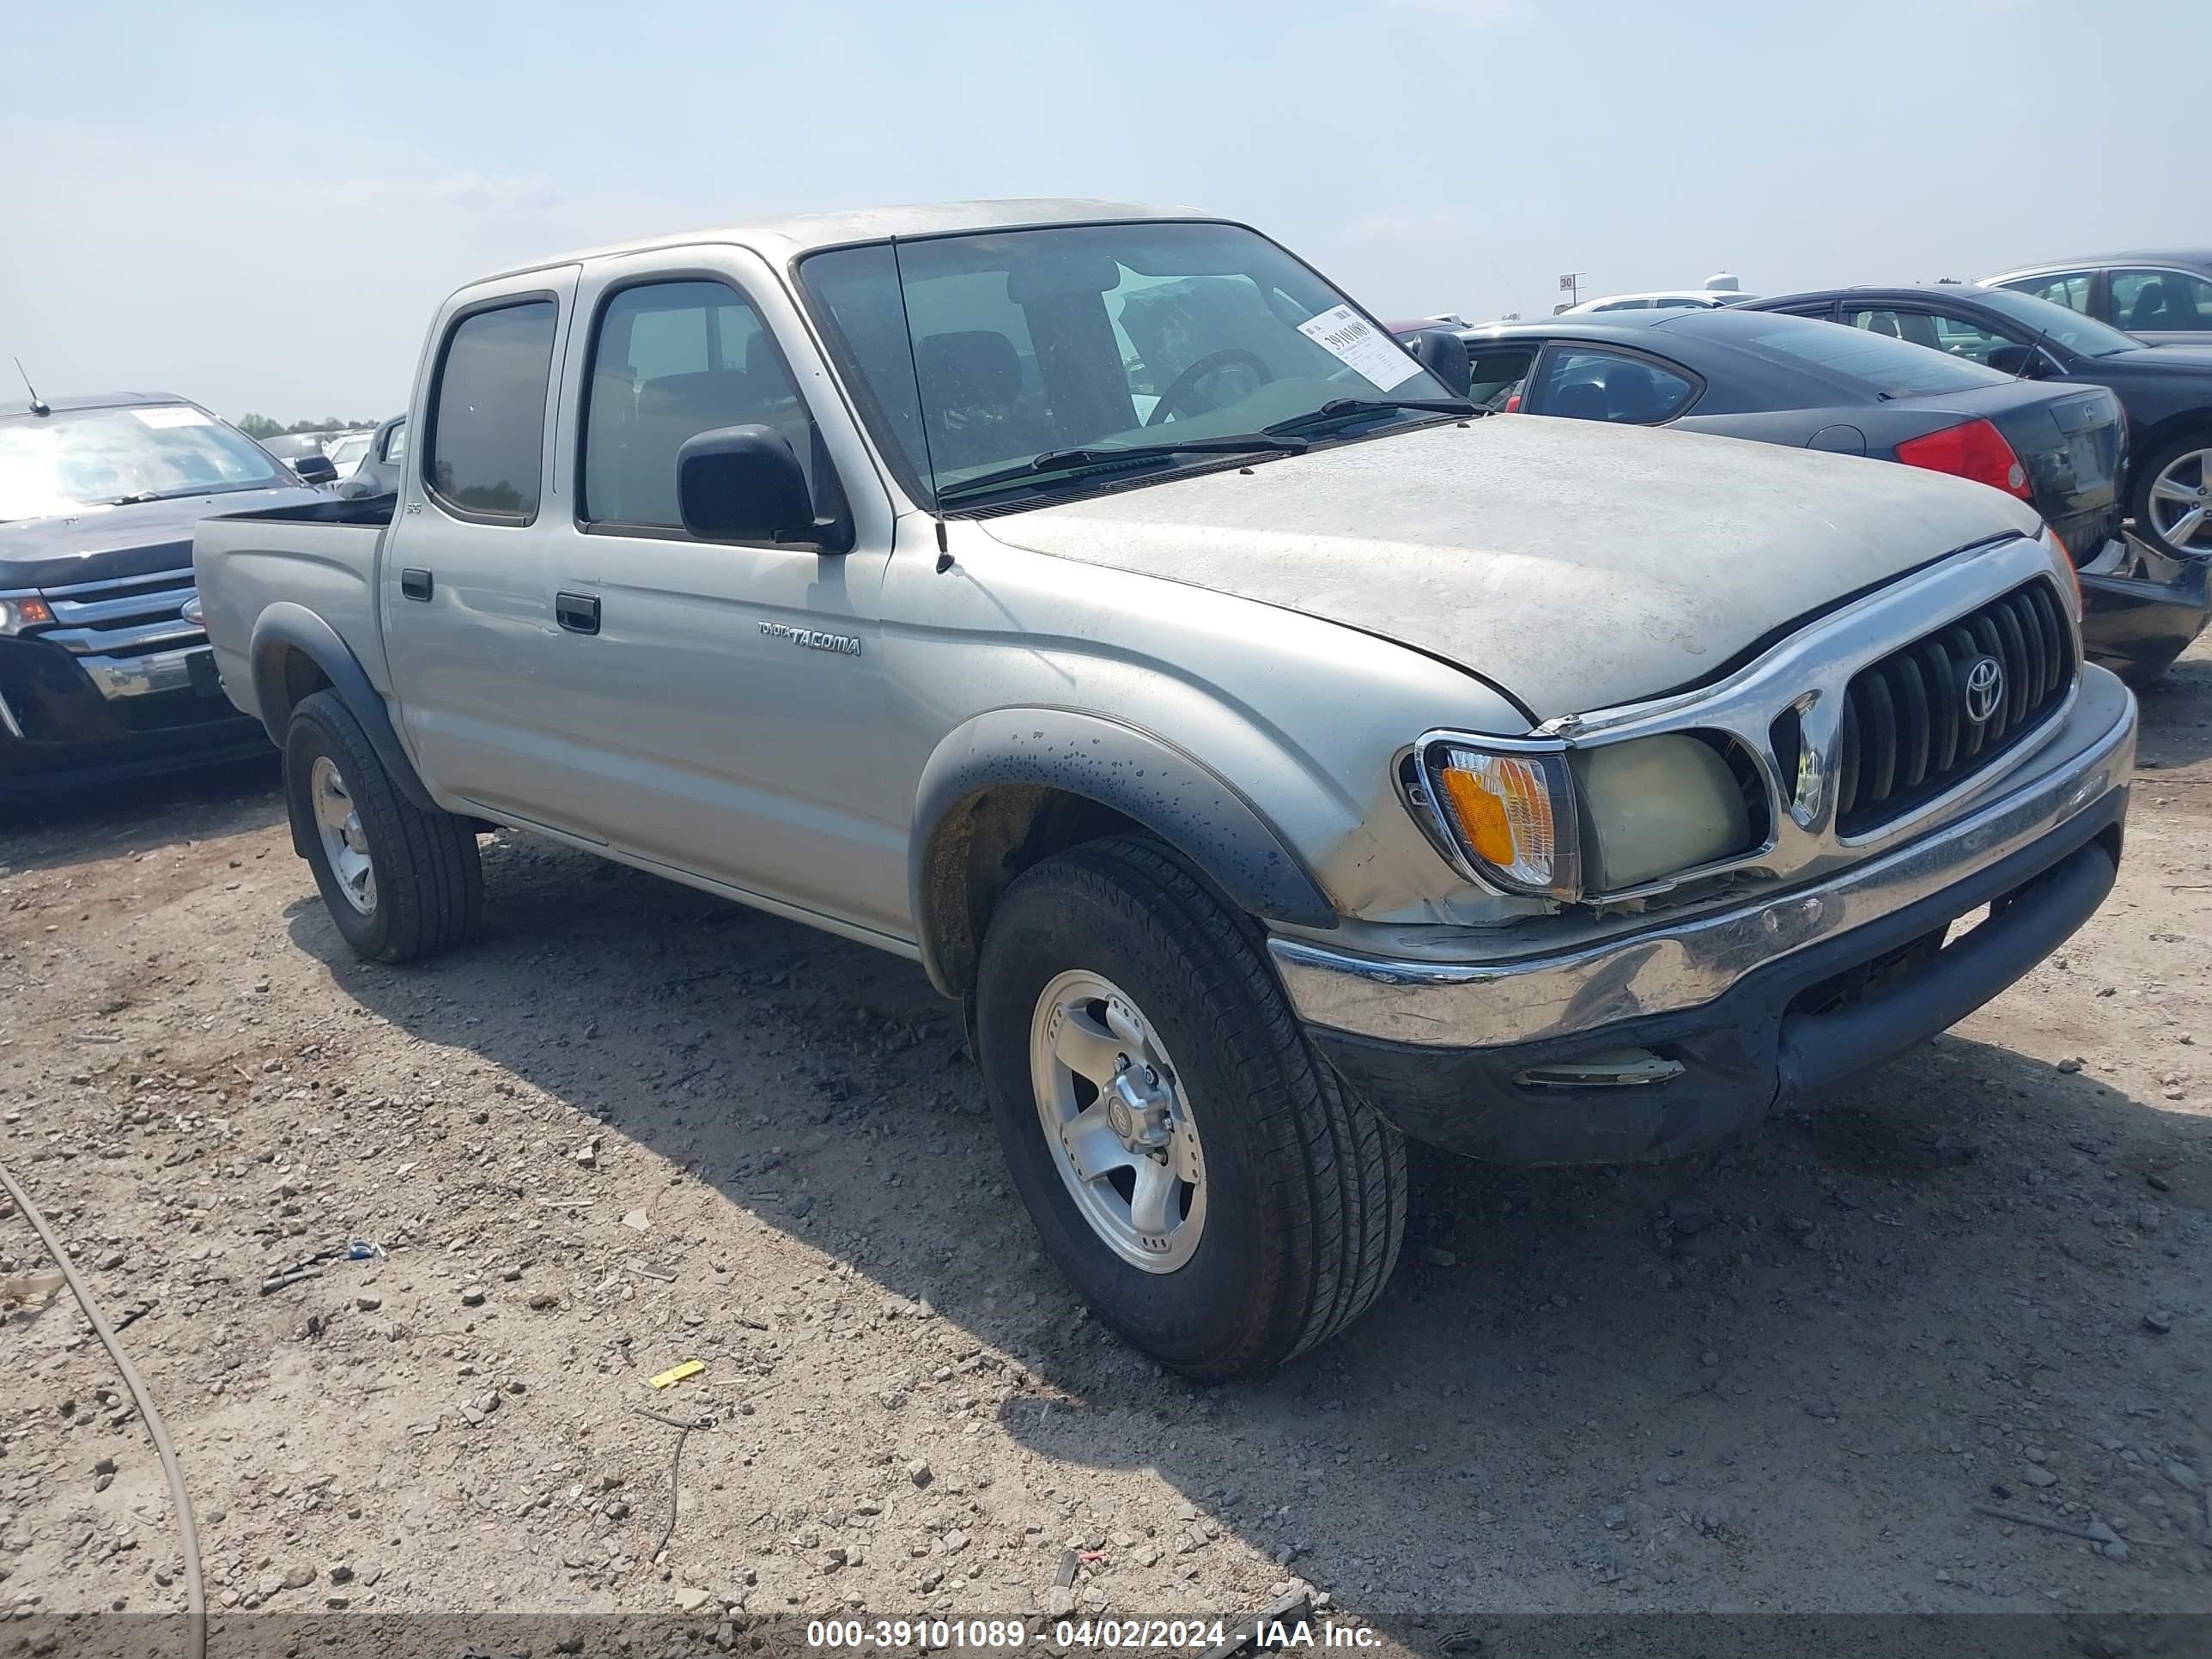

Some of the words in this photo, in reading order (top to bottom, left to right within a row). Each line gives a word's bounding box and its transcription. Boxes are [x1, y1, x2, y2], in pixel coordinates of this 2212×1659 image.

[1560, 277, 1572, 288] 30
[1324, 321, 1371, 350] 39101089
[757, 621, 790, 638] TOYOTA
[789, 628, 861, 656] TACOMA
